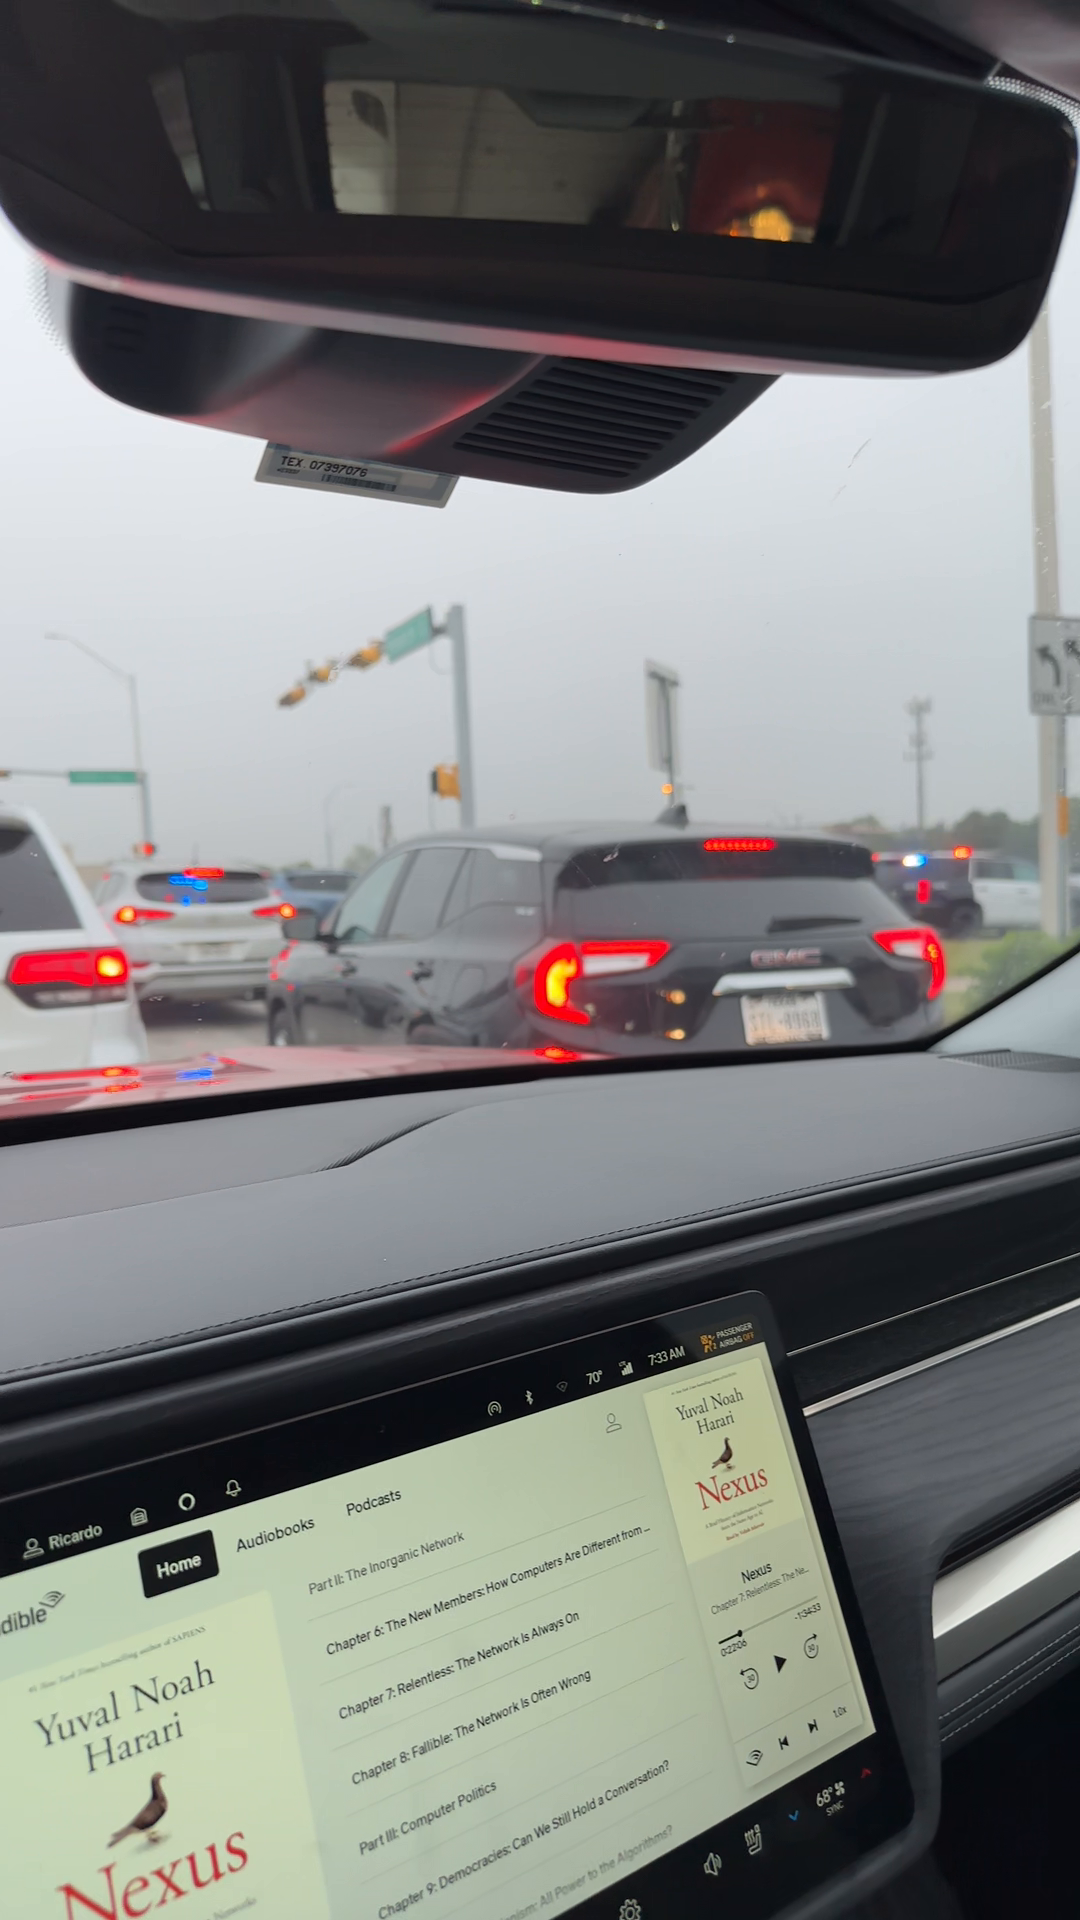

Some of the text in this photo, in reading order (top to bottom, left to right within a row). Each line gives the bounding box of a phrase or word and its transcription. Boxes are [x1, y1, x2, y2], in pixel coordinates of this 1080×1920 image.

[281, 456, 306, 469] TEX.
[309, 460, 368, 478] 07397076
[751, 947, 820, 968] GMC
[716, 1322, 753, 1339] PASSENGER
[719, 1331, 755, 1349] AIRBAG OFF
[648, 1346, 686, 1367] 7:33 AM
[586, 1369, 603, 1385] 70°
[675, 1387, 744, 1422] Yuval Noah
[696, 1411, 735, 1435] Harari
[346, 1489, 402, 1516] Podcasts
[695, 1468, 769, 1511] Nexus
[48, 1525, 103, 1550] Ricardo
[236, 1517, 316, 1552] Audiobooks
[156, 1554, 202, 1579] Home
[308, 1531, 465, 1595] Part II: The Inorganic Network
[741, 1563, 773, 1584] Nexus
[326, 1629, 371, 1655] Chapter
[373, 1625, 385, 1637] 6:
[385, 1617, 407, 1633] The
[408, 1608, 432, 1624] New
[434, 1587, 486, 1614] Members:
[485, 1577, 508, 1595] How
[510, 1557, 563, 1585] Computers
[564, 1550, 582, 1564] Are
[582, 1532, 621, 1556] Different
[621, 1525, 643, 1541] from
[711, 1596, 739, 1615] Chapter
[746, 1577, 782, 1598] Relentless:
[782, 1572, 796, 1583] The
[0, 1606, 47, 1636] dible
[172, 1625, 207, 1643] SAPIENS
[720, 1638, 748, 1657] 0:22:06
[339, 1611, 580, 1720] Chapter 7: Relentless: The Network Is Always On
[33, 1659, 216, 1748] Yuval Noah
[351, 1669, 592, 1785] Chapter 8: Fallible: The Network Is Often Wrong
[84, 1711, 184, 1773] Harari
[816, 1786, 833, 1807] 68°
[826, 1800, 844, 1817] SYNC
[358, 1781, 497, 1855] Part III: Computer Politics
[378, 1759, 670, 1920] Chapter 9: Democracies: Can We Still Hold a Conversation?
[55, 1831, 249, 1920] Nexus
[540, 1890, 554, 1908] All
[554, 1875, 586, 1901] Power
[587, 1868, 598, 1882] to
[599, 1859, 616, 1875] the
[616, 1824, 673, 1865] Algorithms?
